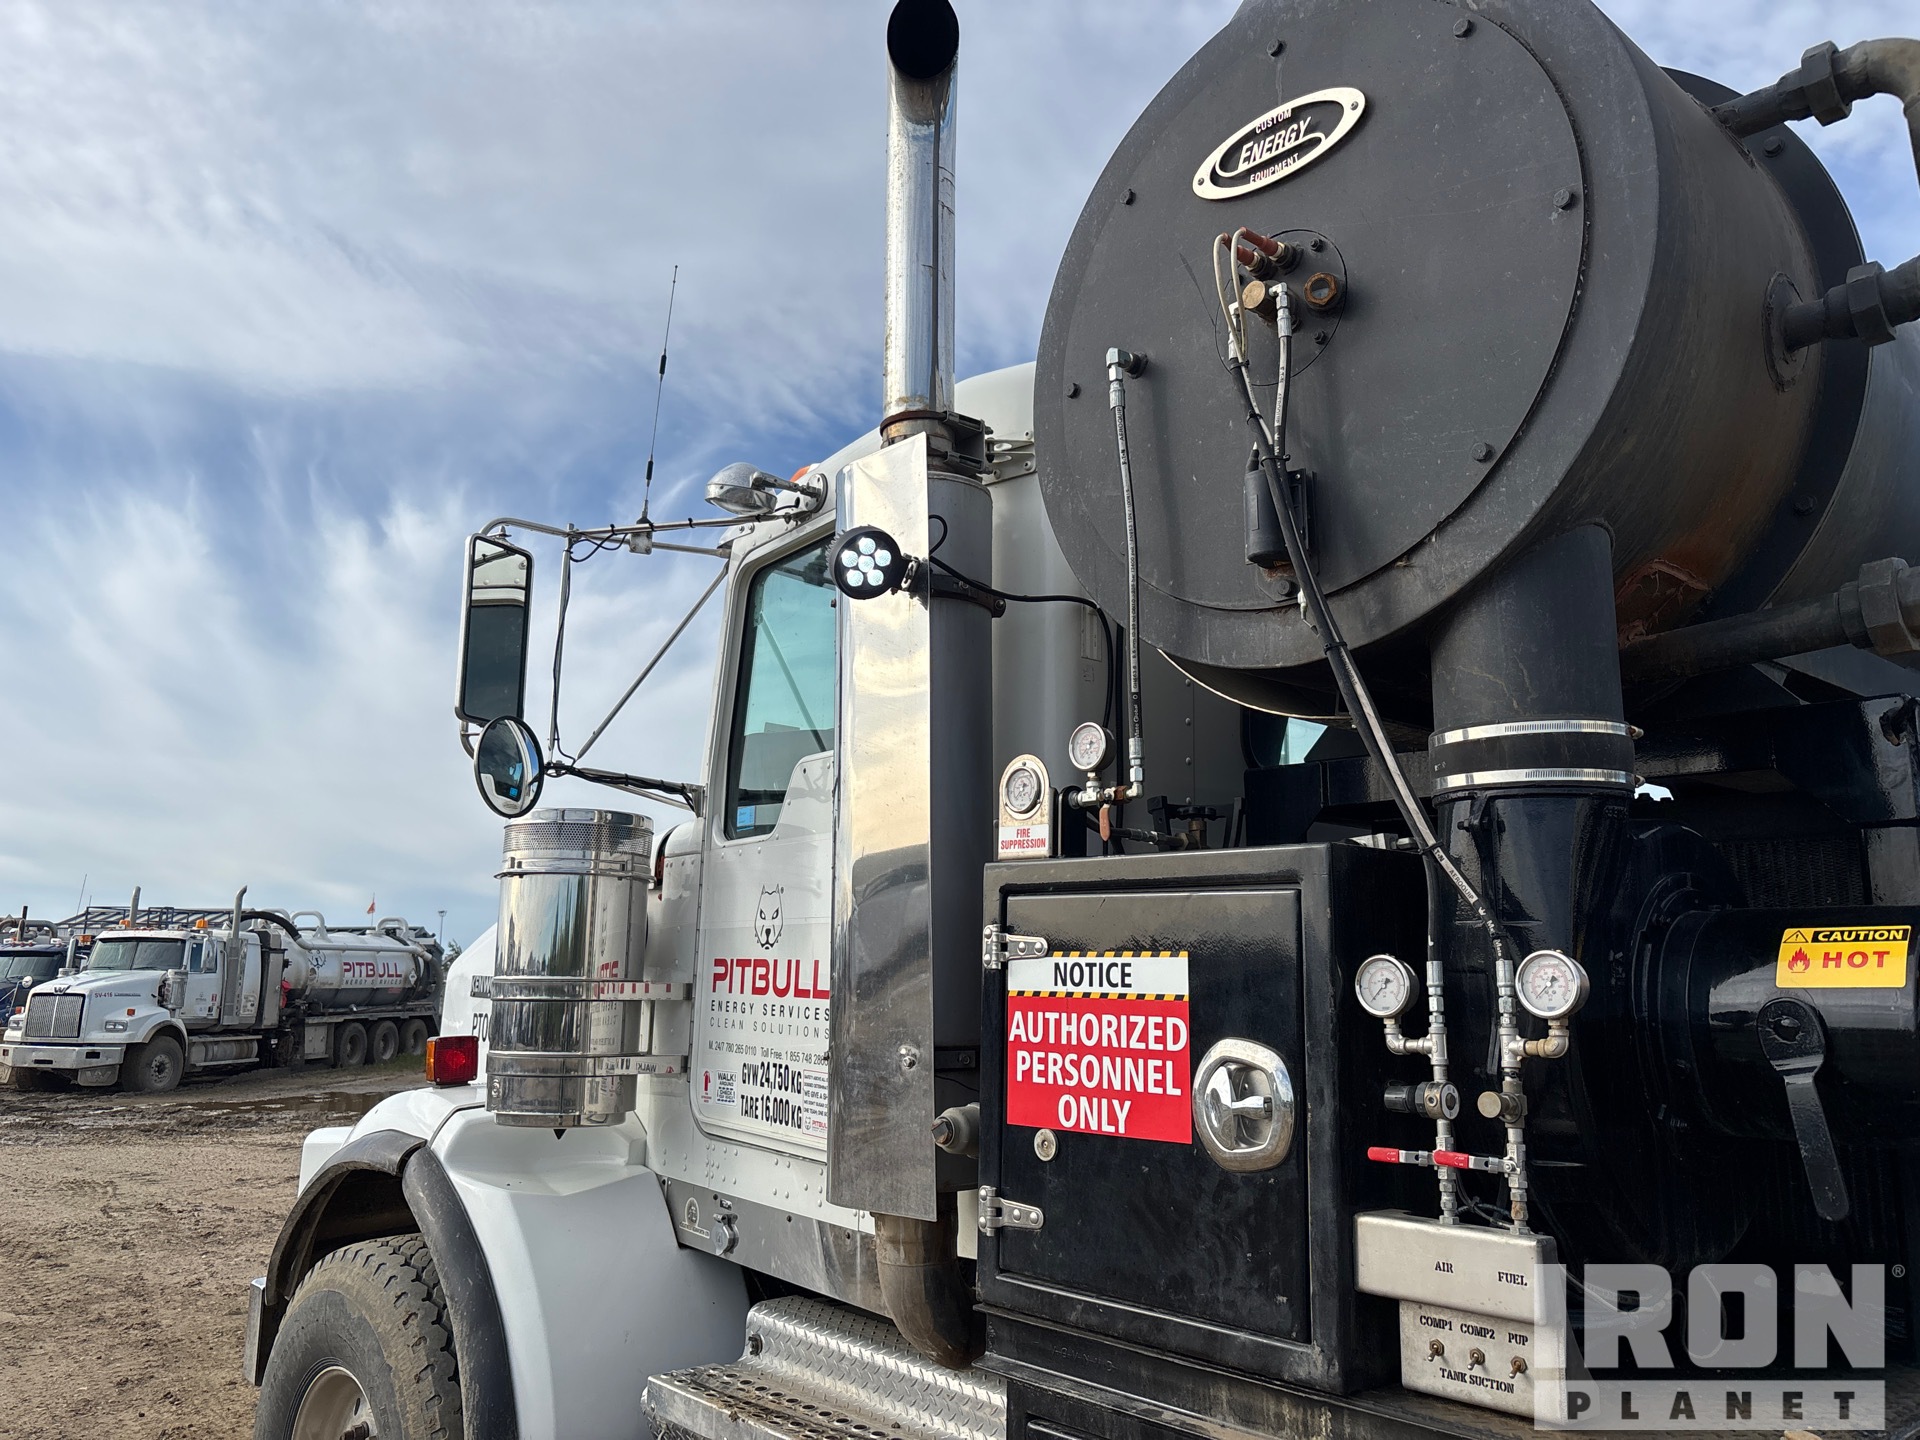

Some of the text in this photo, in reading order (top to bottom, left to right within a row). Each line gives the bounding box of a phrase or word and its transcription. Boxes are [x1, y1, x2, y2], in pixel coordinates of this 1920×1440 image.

[1255, 109, 1292, 134] CUSTOM
[1238, 116, 1312, 170] ENERGY
[1250, 153, 1300, 183] EQUIPMENT
[1000, 838, 1046, 850] SUPPRESSION
[1016, 828, 1031, 838] FIRE
[1449, 870, 1475, 900] AEROQUIP
[1818, 930, 1904, 941] CAUTION
[343, 962, 402, 978] PITBULL
[1822, 951, 1891, 969] HOT
[712, 958, 830, 1000] PITBULL
[1053, 962, 1133, 988] NOTICE
[711, 1000, 830, 1022] ENERGY SERVICES
[710, 1016, 829, 1040] CLEAN SOLUTIONS
[1009, 1011, 1188, 1052] AUTHORIZED
[725, 1042, 734, 1053] 780
[735, 1043, 744, 1054] 265
[745, 1045, 757, 1056] 0110
[761, 1046, 769, 1058] Toll
[790, 1051, 800, 1063] 855
[801, 1052, 812, 1065] 748
[742, 1061, 802, 1095] GVW 24,750 KG
[1016, 1050, 1182, 1096] PERSONNEL
[740, 1094, 759, 1119] TARE
[760, 1094, 790, 1126] 16,000
[791, 1104, 802, 1129] KG
[1057, 1094, 1132, 1134] ONLY
[1434, 1261, 1454, 1274] AIR
[1498, 1271, 1528, 1286] FUEL
[1419, 1315, 1529, 1346] COMP1 COMP2 PUP
[1440, 1367, 1515, 1394] TANK SUCTION
